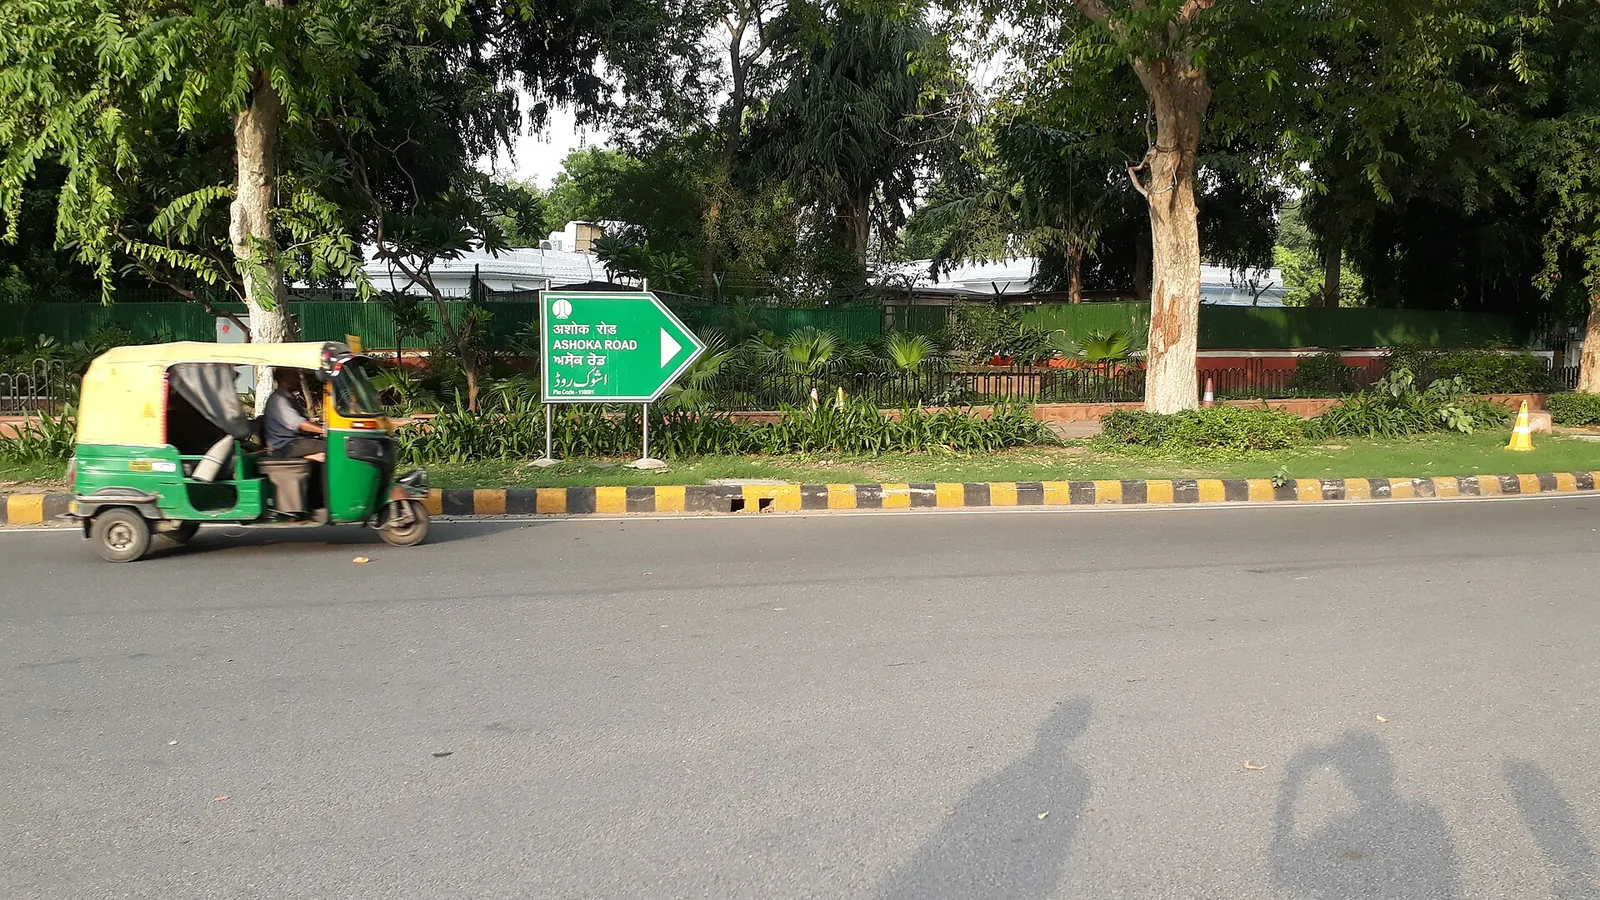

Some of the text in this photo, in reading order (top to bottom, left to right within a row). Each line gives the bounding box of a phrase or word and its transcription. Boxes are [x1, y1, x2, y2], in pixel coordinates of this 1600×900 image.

[553, 320, 617, 335] अशोक रोड
[553, 339, 638, 350] ASHOKA ROAD
